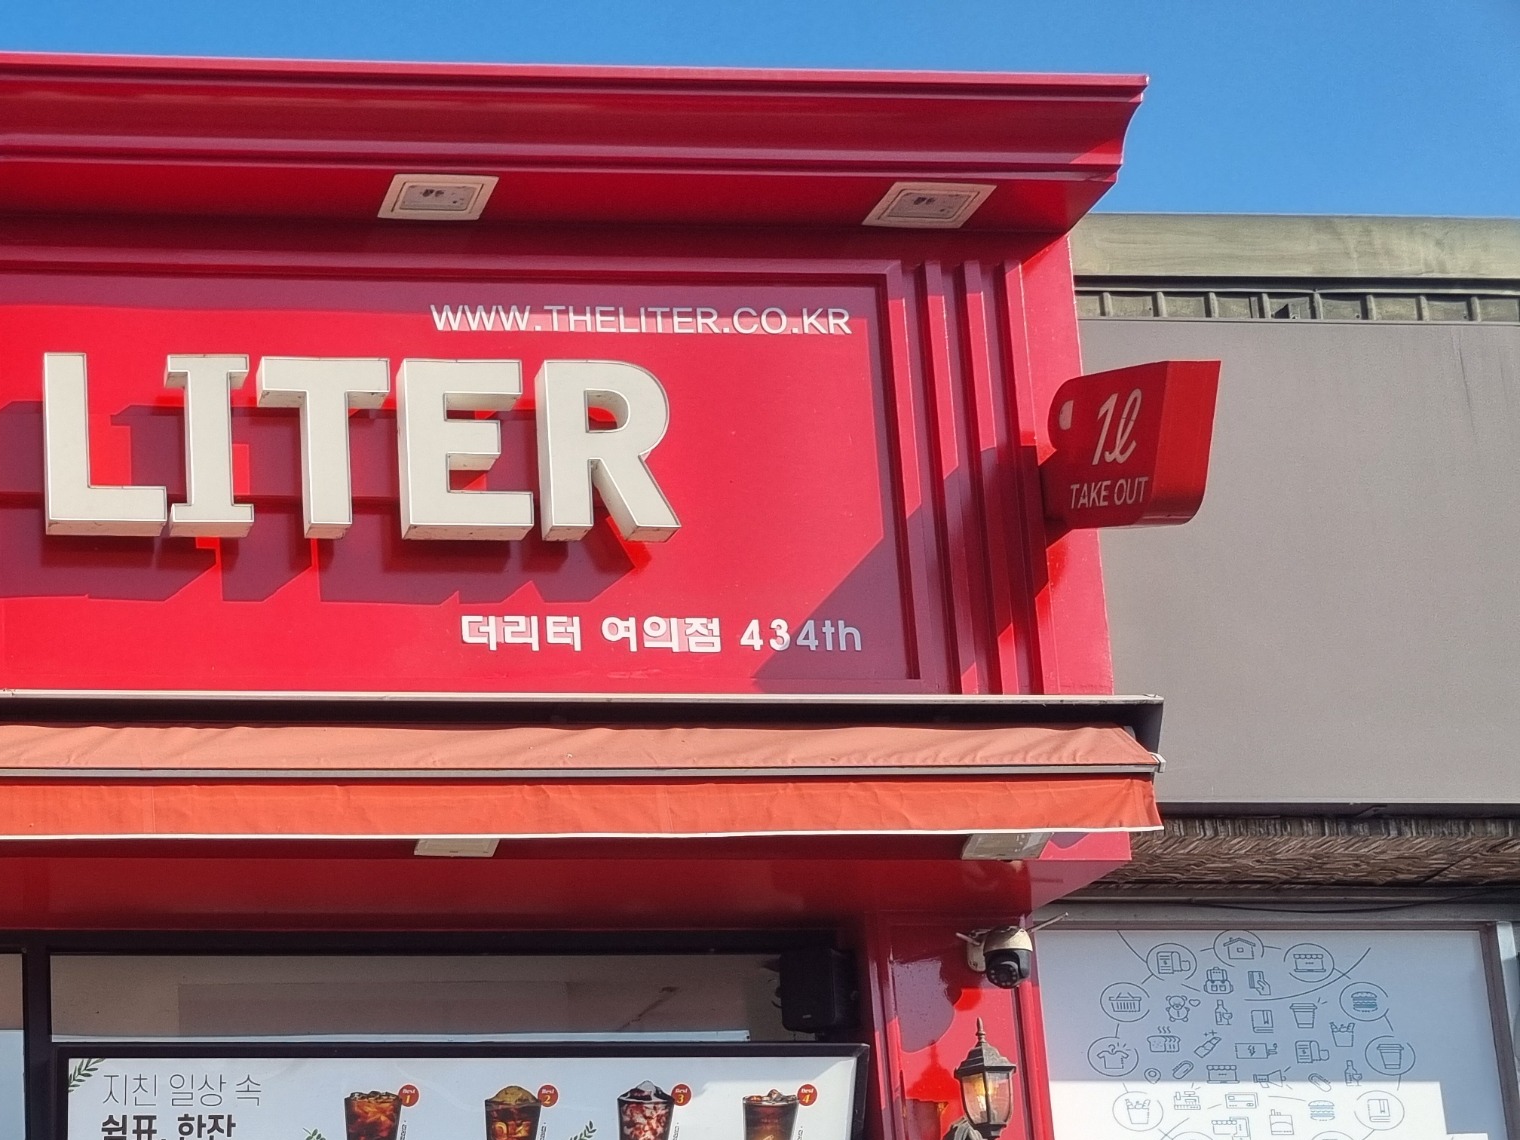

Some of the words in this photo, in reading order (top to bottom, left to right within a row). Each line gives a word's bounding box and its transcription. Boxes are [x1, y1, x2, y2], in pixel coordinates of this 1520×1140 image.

[430, 303, 853, 336] WWW.THELITER.CO.KR
[42, 351, 682, 543] LITER
[1070, 480, 1111, 509] TAKE
[1114, 476, 1149, 505] OUT
[460, 614, 582, 652] 더리터
[601, 614, 722, 653] 여의점
[740, 618, 863, 652] 434th
[102, 1073, 158, 1107] 지친
[169, 1073, 227, 1107] 일상
[235, 1073, 262, 1107] 속
[405, 1095, 411, 1104] 1
[544, 1095, 551, 1104] 2
[677, 1094, 684, 1104] 3
[802, 1094, 811, 1104] 4
